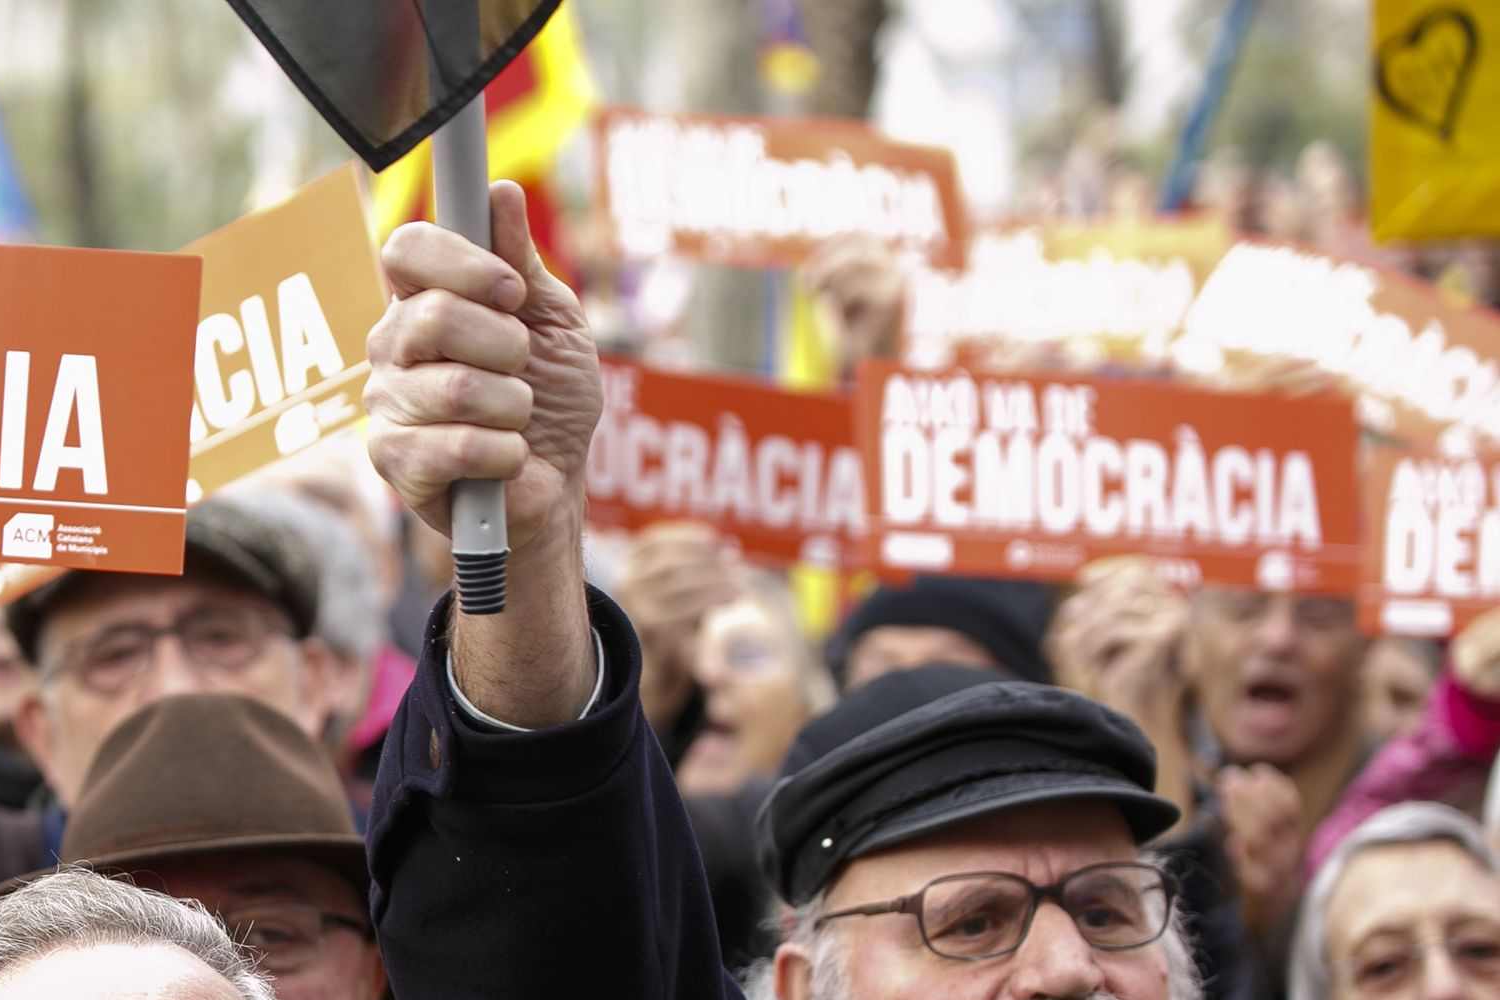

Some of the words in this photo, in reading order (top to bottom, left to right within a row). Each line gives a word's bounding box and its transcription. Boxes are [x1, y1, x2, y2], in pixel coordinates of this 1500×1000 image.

[190, 272, 344, 442] CIA
[13, 528, 51, 543] ACM
[883, 422, 1324, 551] DEMOCRÀCIA
